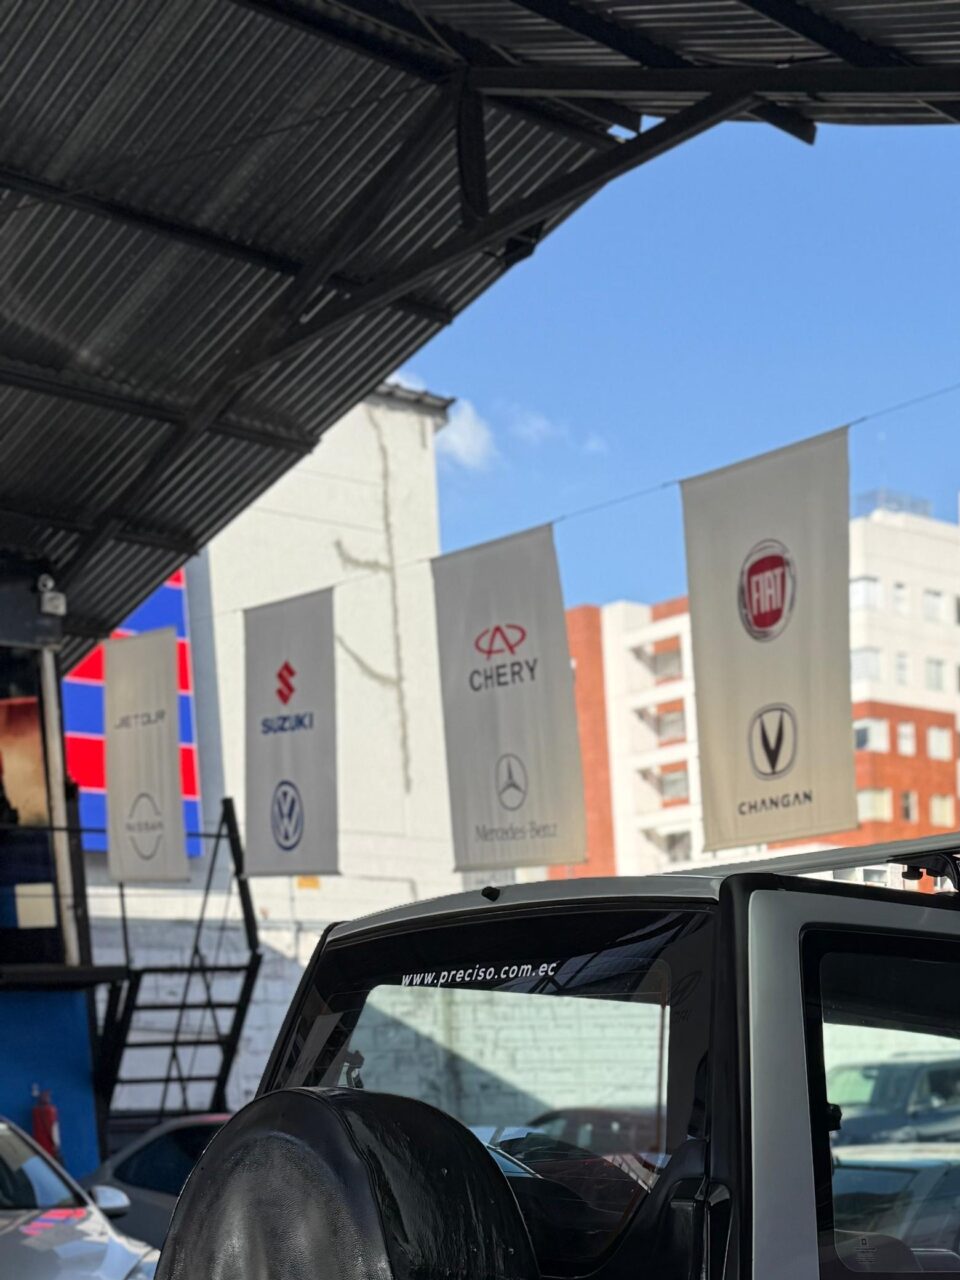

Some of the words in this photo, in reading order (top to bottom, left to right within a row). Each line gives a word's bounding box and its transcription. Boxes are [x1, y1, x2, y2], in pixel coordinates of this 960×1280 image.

[750, 565, 785, 617] FIAT
[468, 657, 539, 693] CHERY
[260, 711, 314, 735] SUZUKI
[737, 788, 814, 817] CHANGAN
[474, 819, 558, 844] Mercedes-Benz
[401, 961, 559, 989] www.preciso.com.ec
